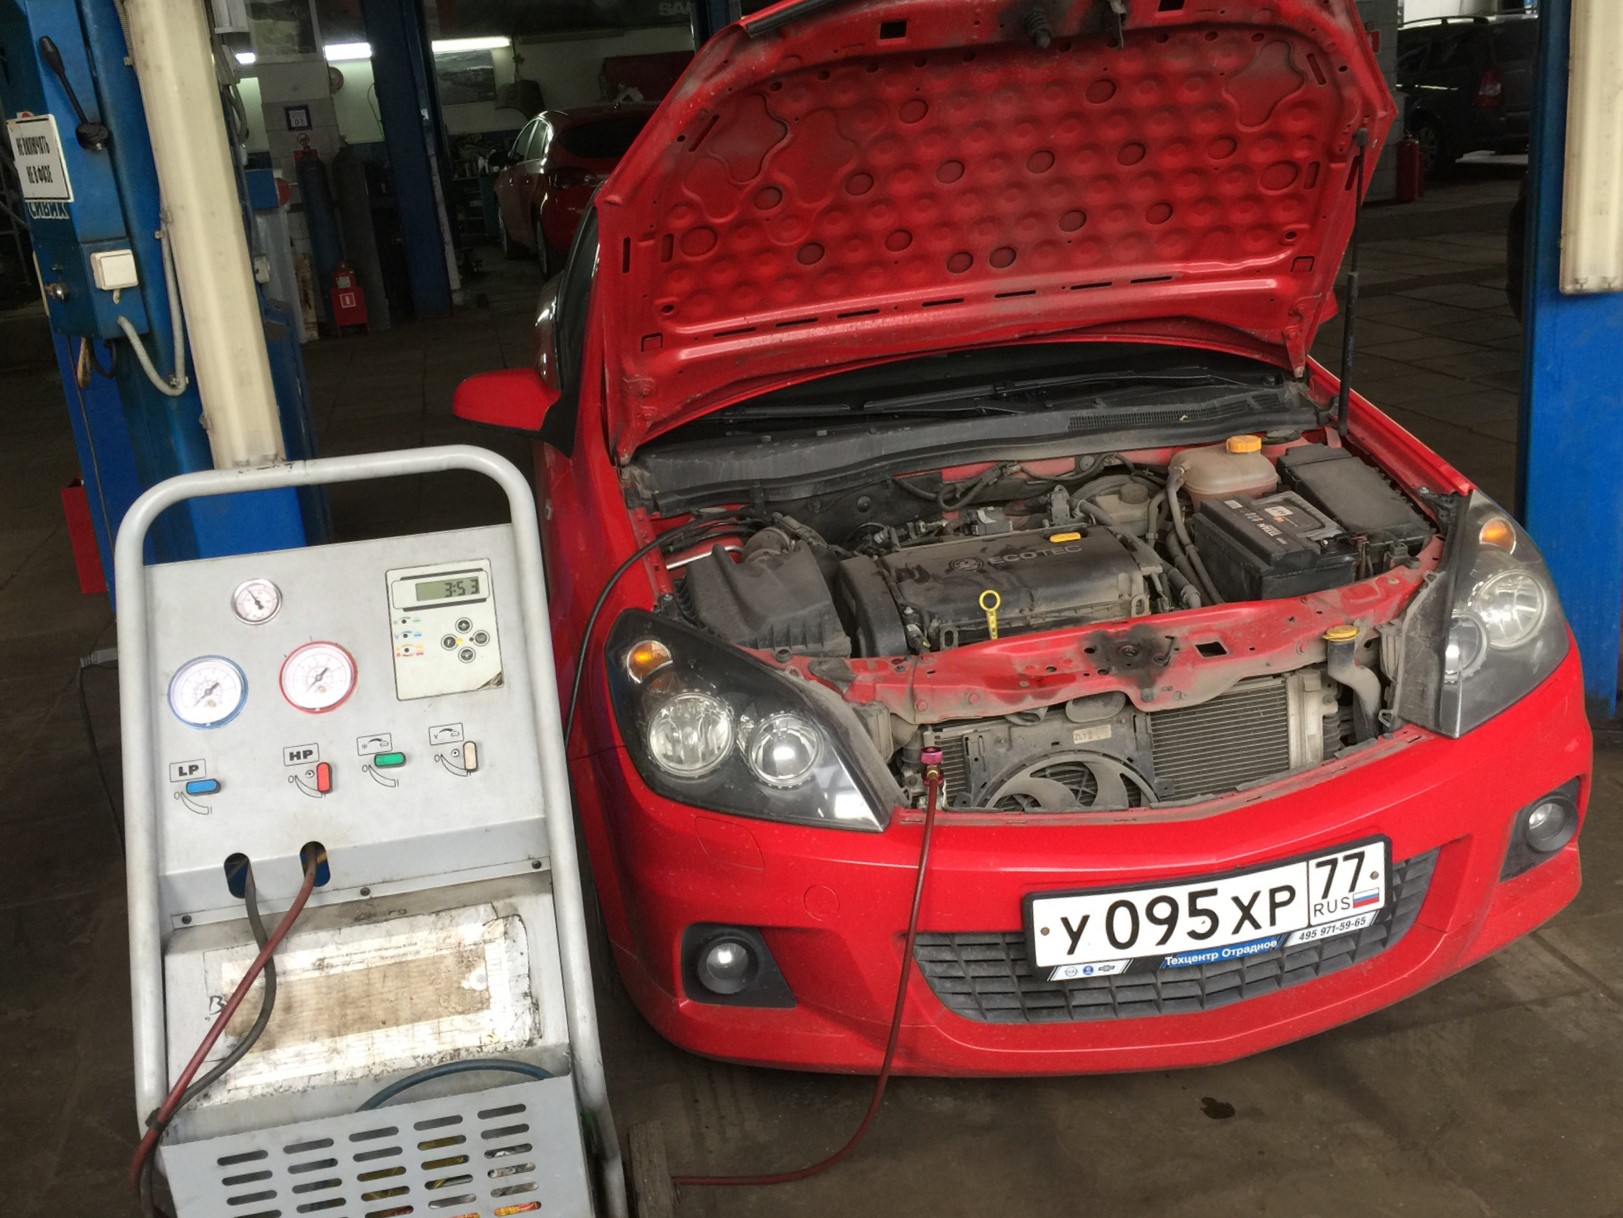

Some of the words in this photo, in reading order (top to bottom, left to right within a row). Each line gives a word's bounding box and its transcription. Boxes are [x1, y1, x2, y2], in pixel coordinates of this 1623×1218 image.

[26, 165, 35, 184] НЕ
[37, 164, 53, 184] ФАЗЕ
[988, 544, 1082, 565] ECOTEC
[289, 749, 313, 761] HP
[178, 764, 199, 777] LP
[1315, 851, 1366, 900] 77
[1313, 896, 1351, 918] RUS
[1299, 929, 1318, 941] 495
[1320, 916, 1367, 936] 971-59-65
[1165, 951, 1219, 965] Техцентр
[1221, 940, 1277, 957] Отрадное
